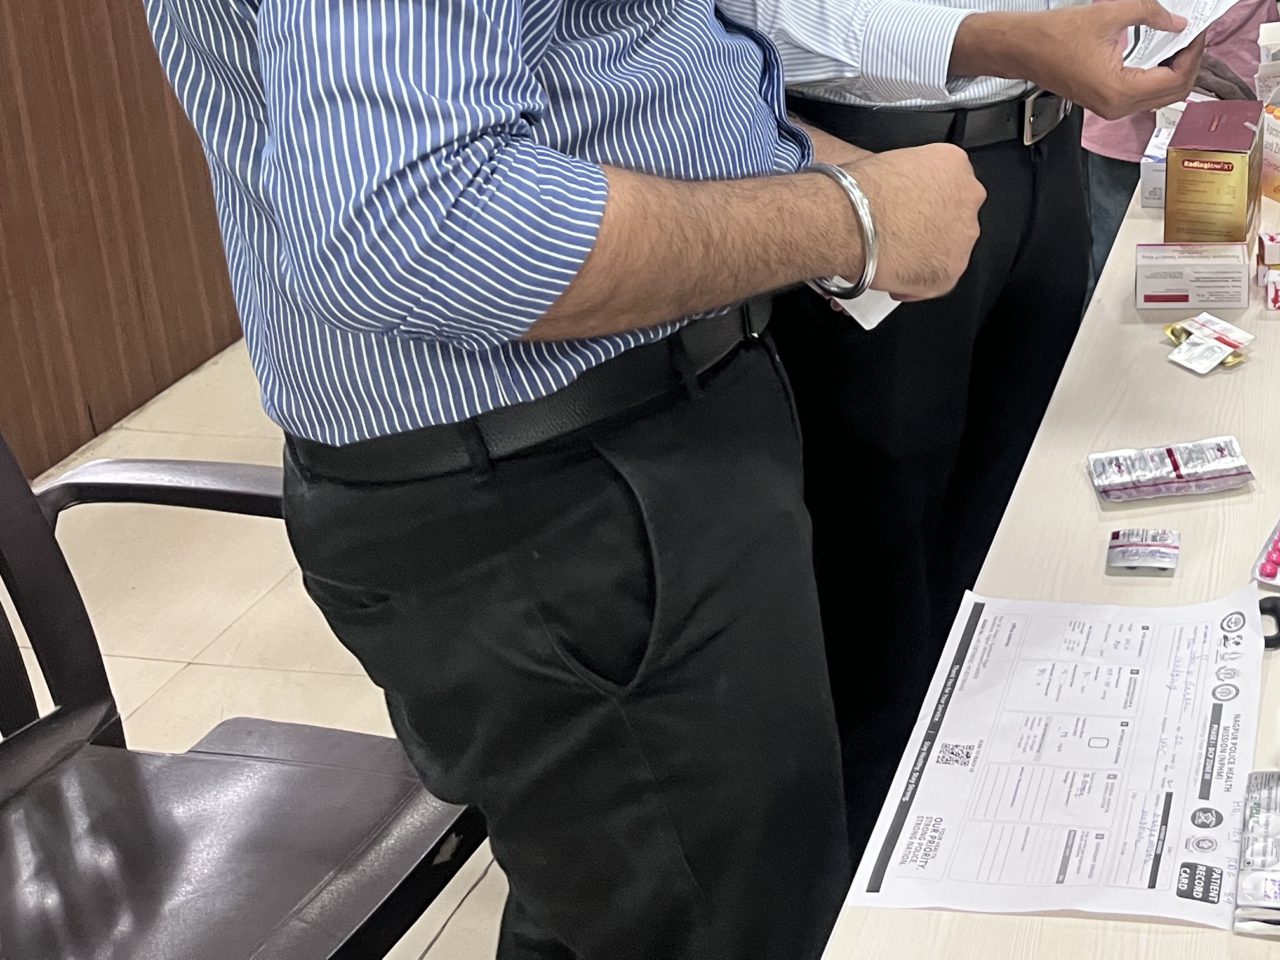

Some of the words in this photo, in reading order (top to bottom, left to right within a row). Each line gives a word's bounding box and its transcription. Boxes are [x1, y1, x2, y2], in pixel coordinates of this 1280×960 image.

[1219, 725, 1230, 753] MISSION
[1230, 713, 1241, 740] NAGPUR
[1227, 741, 1238, 765] POLICE
[1214, 755, 1226, 780] (NPHM)
[1224, 767, 1235, 793] HEALTH
[909, 815, 924, 841] STRONG
[918, 816, 933, 841] STRONG
[932, 816, 944, 834] OUR
[1178, 867, 1190, 890] CARD
[1193, 865, 1206, 898] RECORD
[1209, 867, 1221, 902] PATIENT
